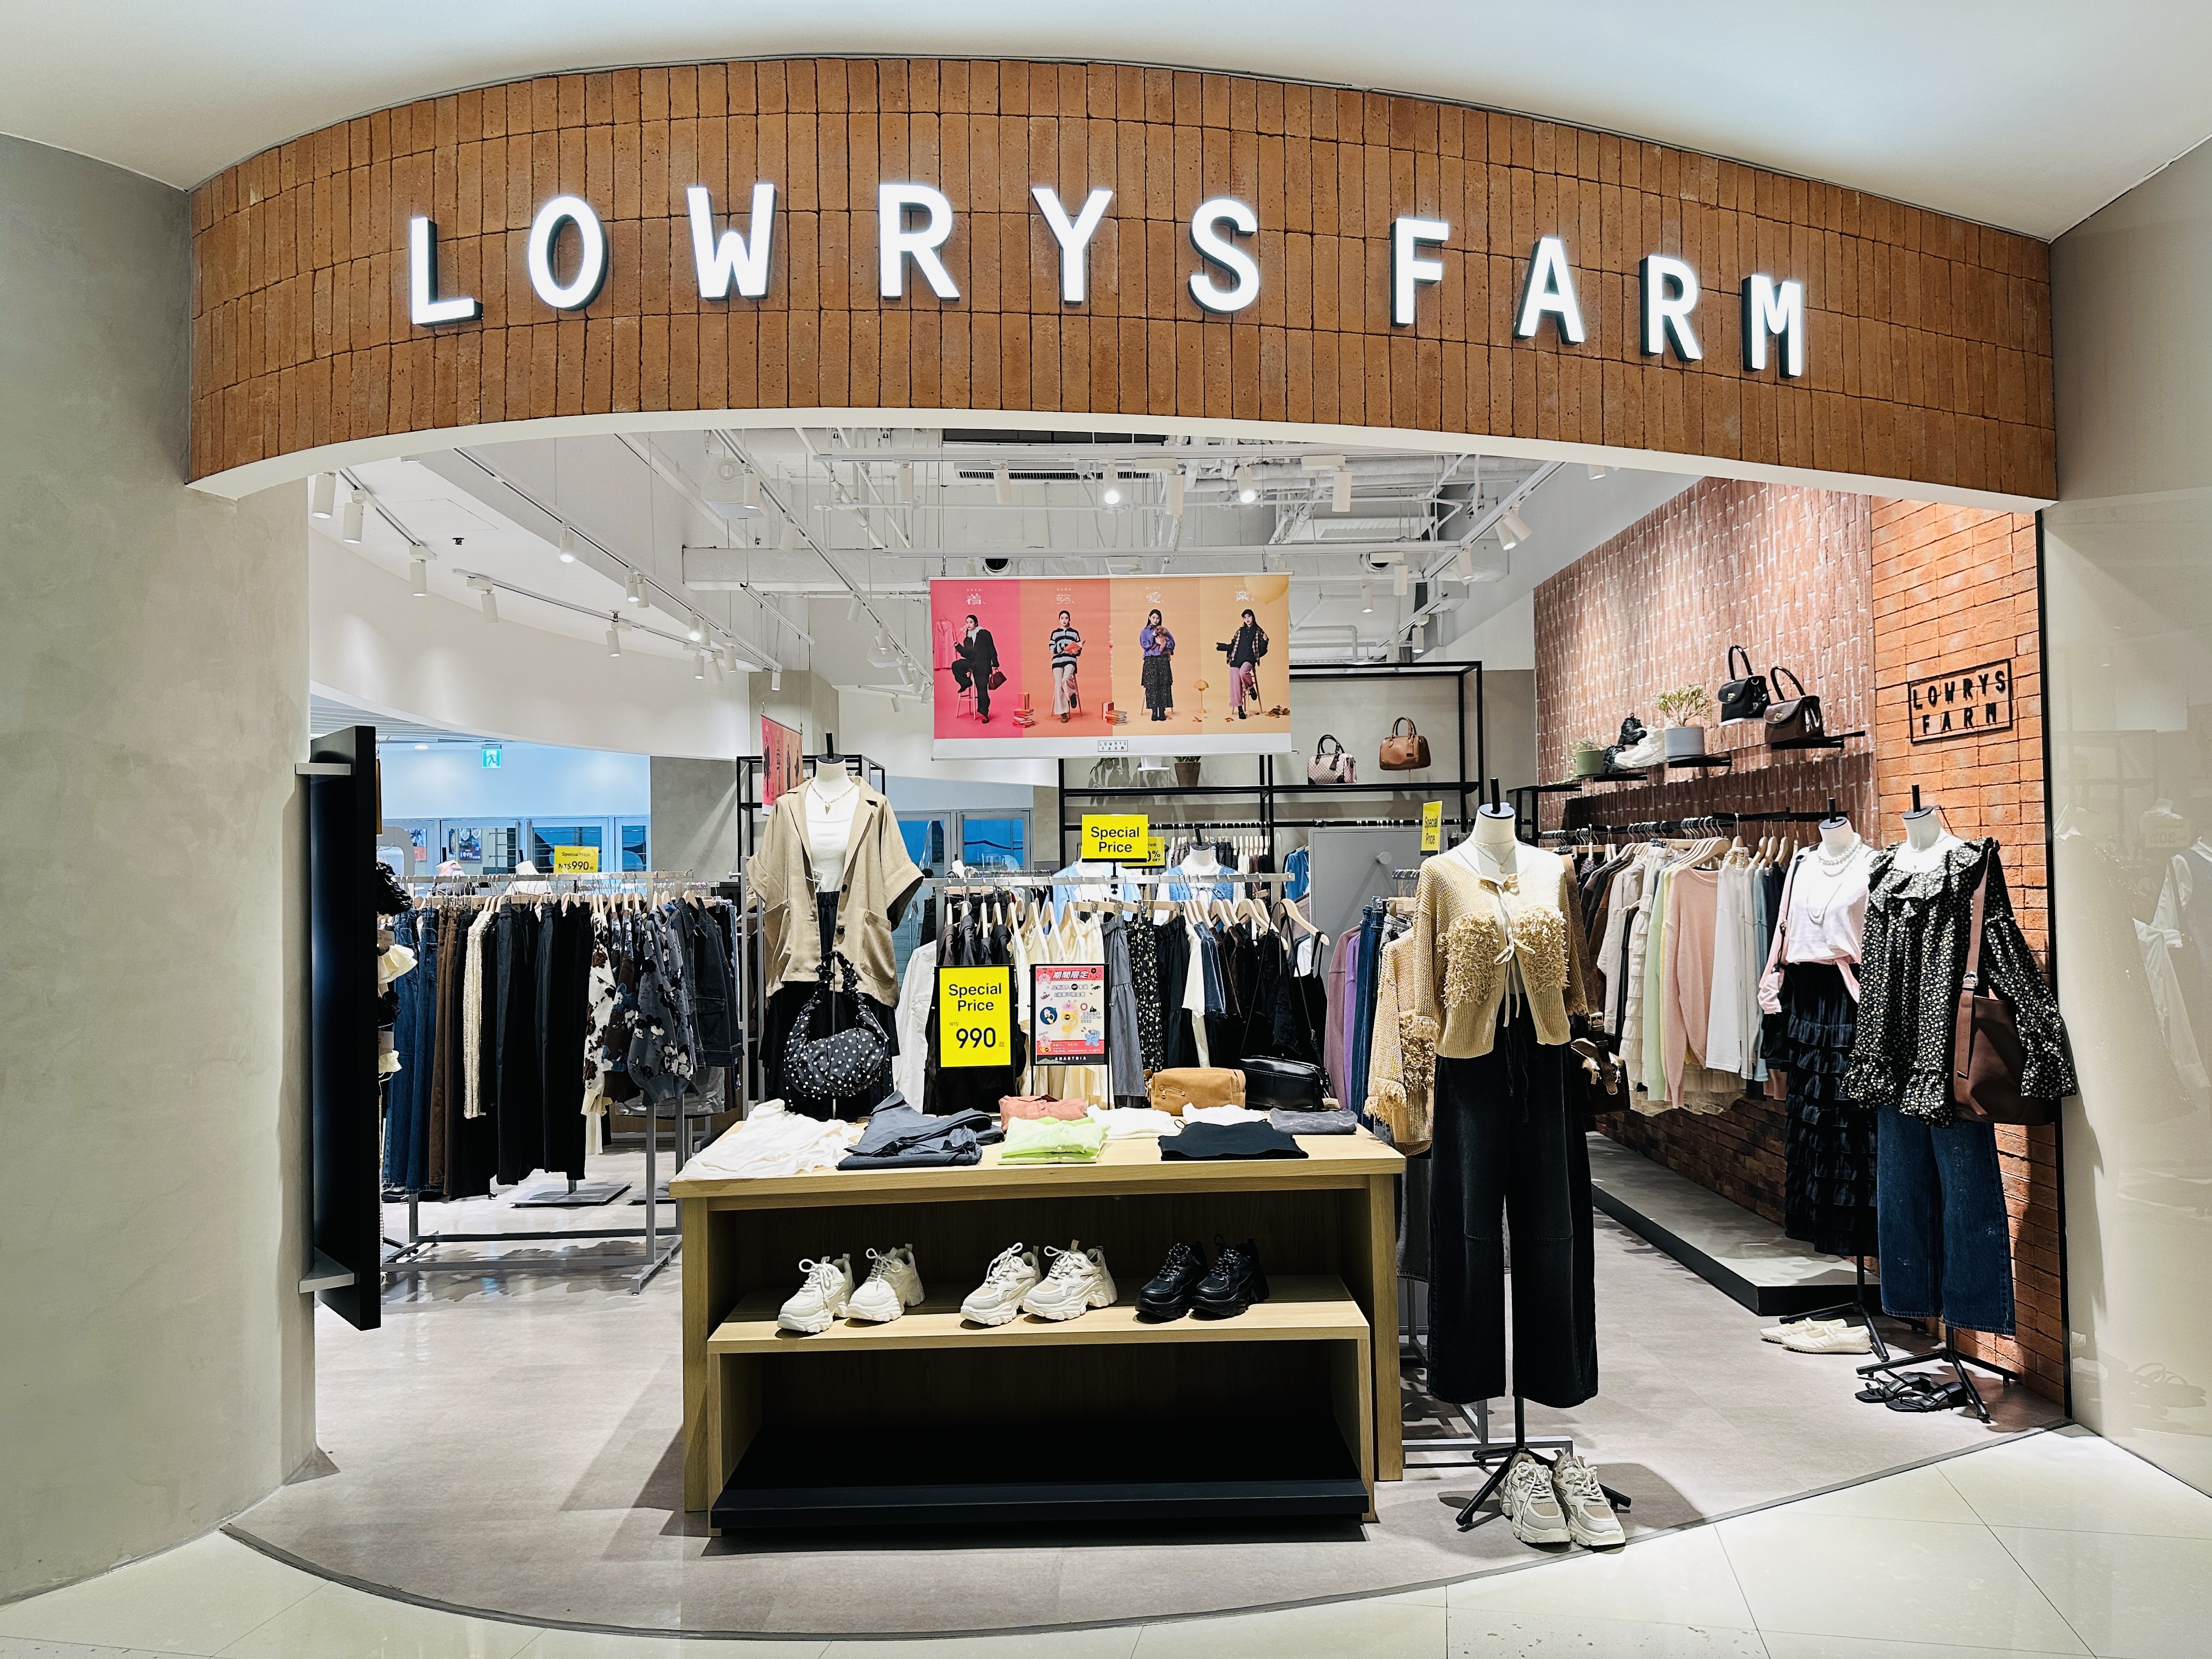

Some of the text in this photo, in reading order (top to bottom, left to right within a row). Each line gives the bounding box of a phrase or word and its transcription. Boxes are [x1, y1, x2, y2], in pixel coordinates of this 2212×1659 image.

[410, 183, 1804, 380] LOWRYS FARM
[1913, 670, 2006, 709] LOWRYS
[1922, 702, 1997, 734] FARM
[1425, 815, 1438, 831] Special
[1091, 826, 1139, 840] Special
[1426, 832, 1435, 845] Price
[1099, 841, 1132, 853] Price
[1052, 970, 1089, 979] 期間限定
[949, 983, 1001, 998] Special
[958, 999, 994, 1012] Price
[956, 1027, 996, 1048] 990
